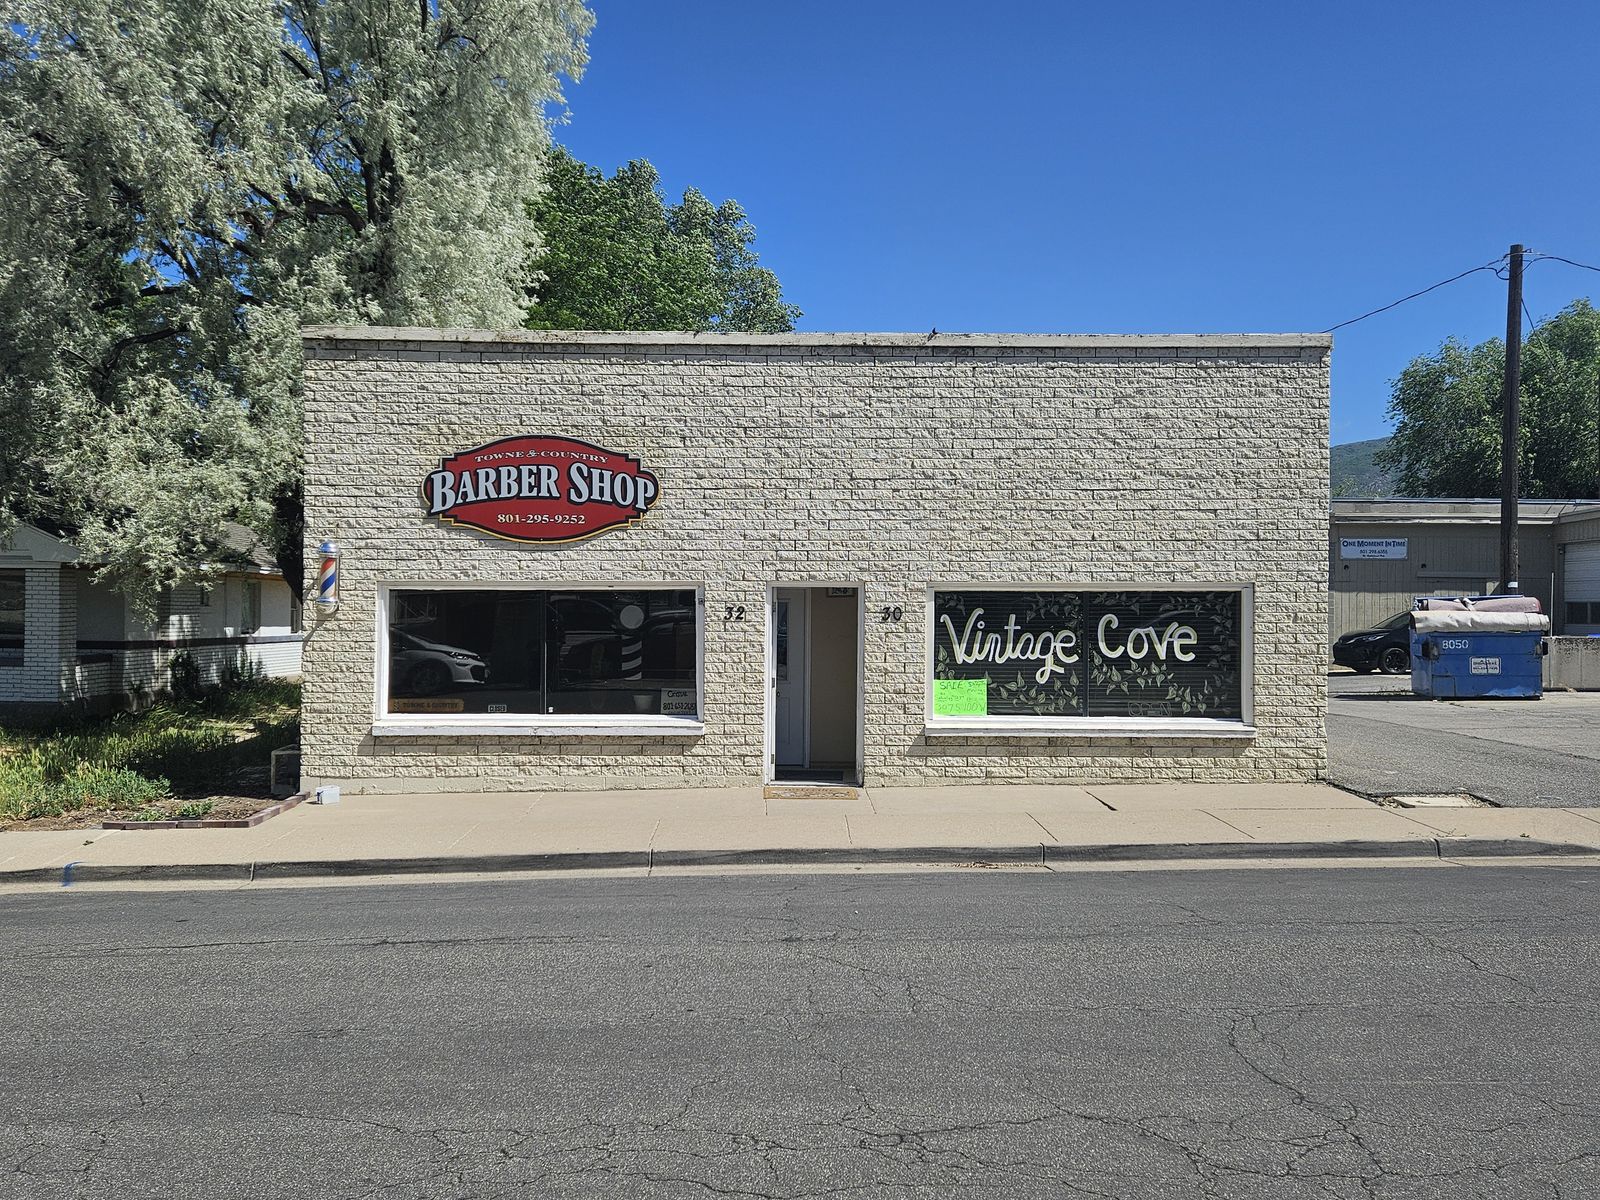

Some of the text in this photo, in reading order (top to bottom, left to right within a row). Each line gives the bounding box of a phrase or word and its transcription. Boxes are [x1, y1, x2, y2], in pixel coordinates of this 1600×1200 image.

[474, 449, 608, 463] TOWNE & COUNTRY
[430, 462, 656, 514] BARBER SHOP
[497, 513, 586, 525] 801-295-9252
[723, 605, 745, 620] 32
[881, 606, 902, 621] 30
[939, 607, 1198, 684] Vintage Cove
[1442, 639, 1469, 649] 8050
